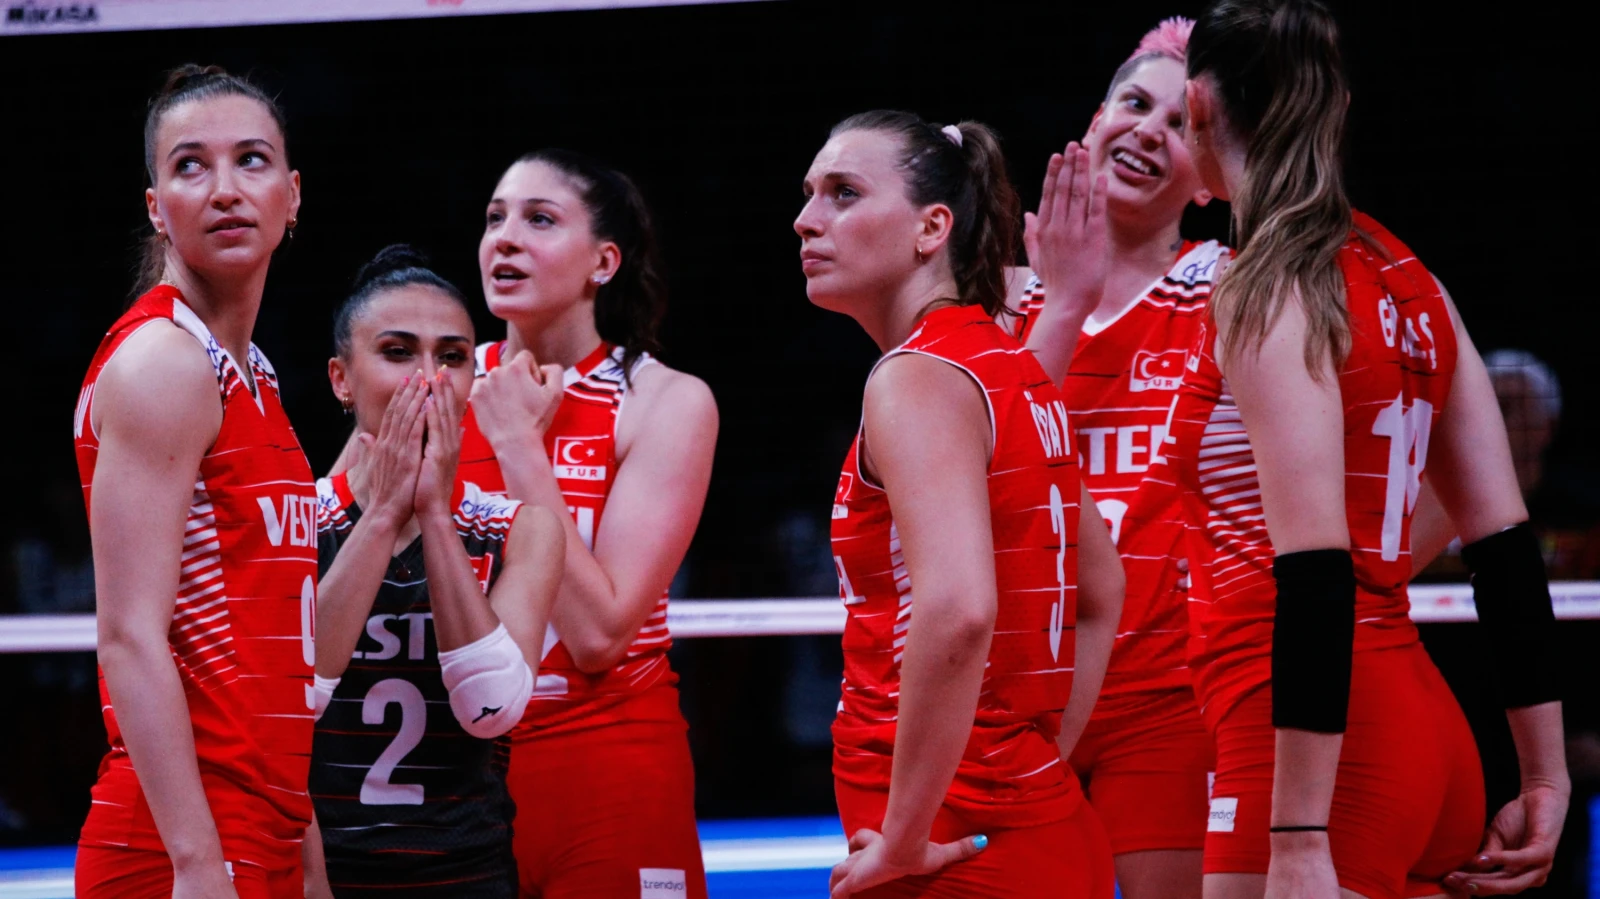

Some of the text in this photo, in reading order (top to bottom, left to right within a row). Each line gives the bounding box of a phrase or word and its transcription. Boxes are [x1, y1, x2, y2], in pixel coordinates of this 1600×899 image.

[1144, 379, 1173, 388] TUR
[566, 467, 598, 478] TUR
[1050, 484, 1066, 663] 3
[359, 678, 427, 805] 2
